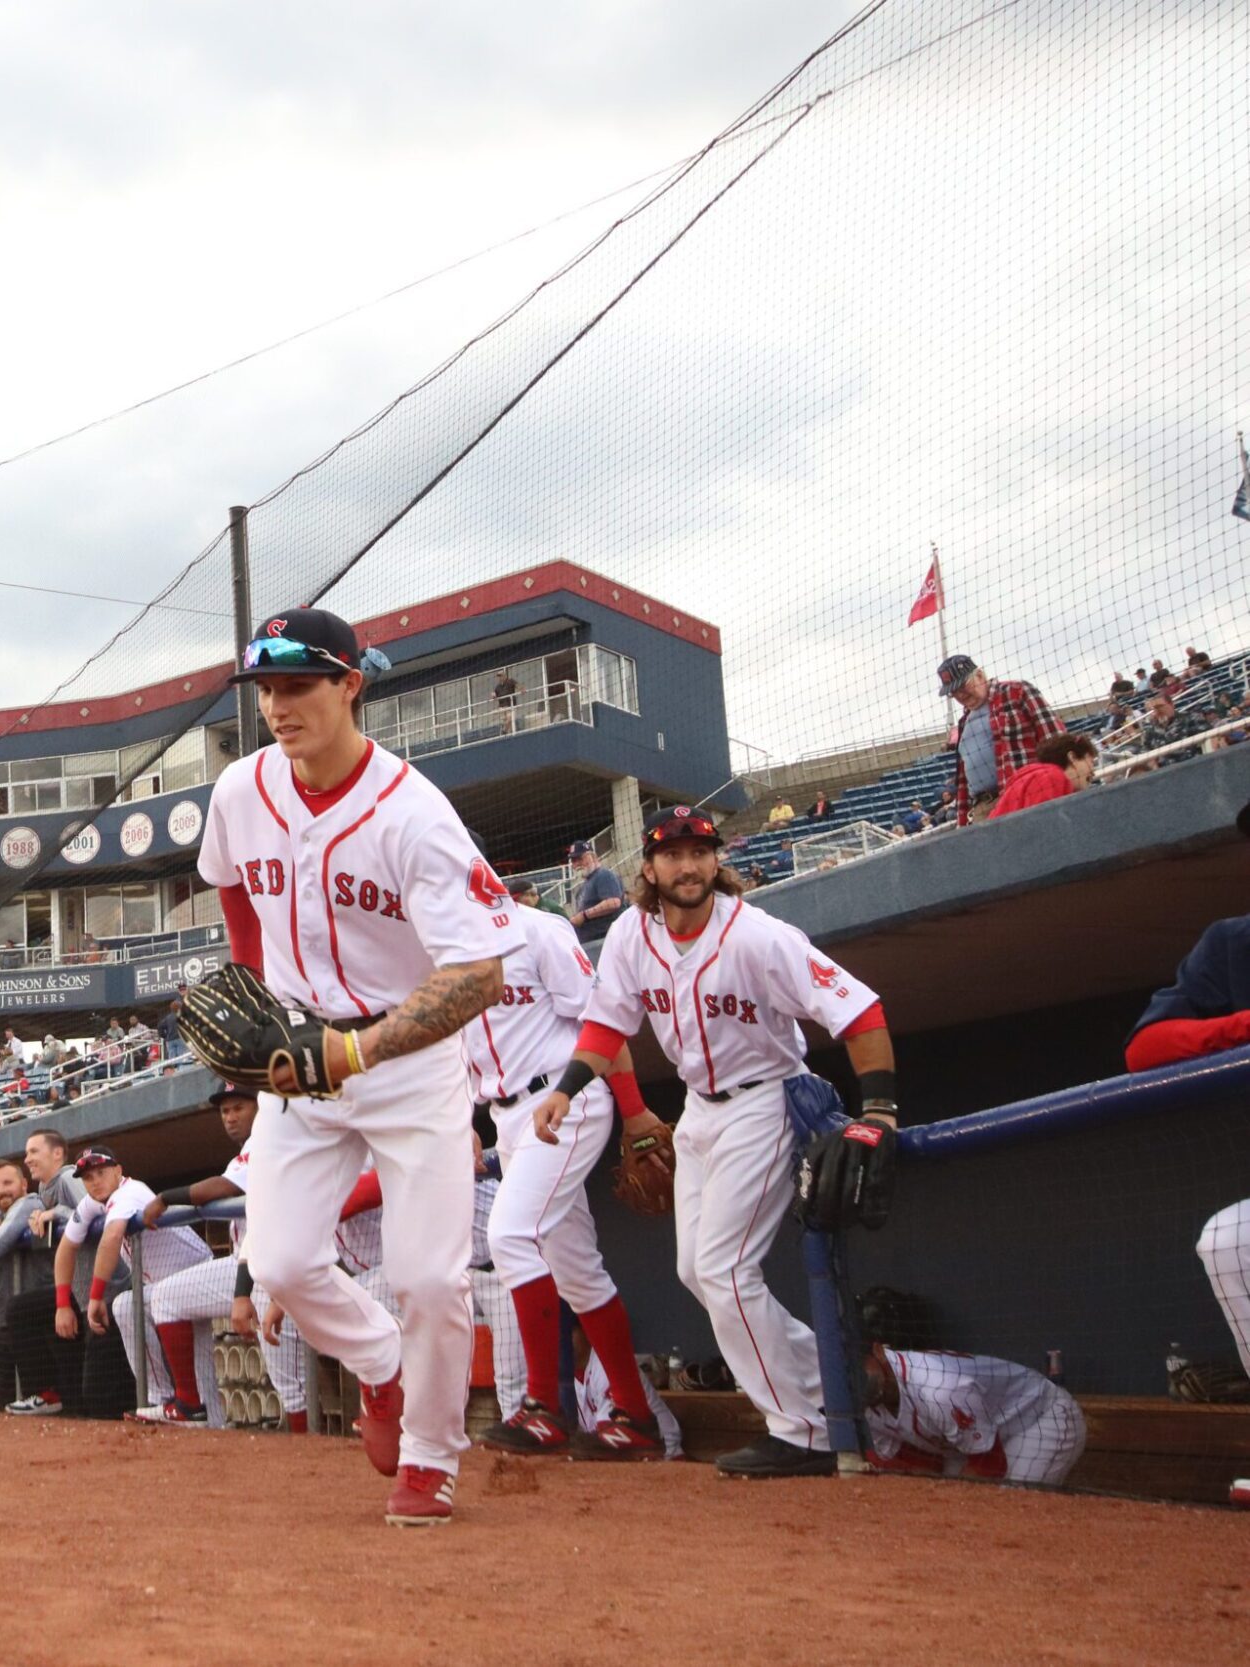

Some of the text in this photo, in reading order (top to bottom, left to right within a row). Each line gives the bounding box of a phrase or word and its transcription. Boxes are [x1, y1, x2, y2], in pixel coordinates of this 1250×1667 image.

[173, 814, 197, 833] 2009
[125, 827, 150, 844] 2006
[6, 841, 35, 856] 1988
[334, 872, 408, 922] SOX
[46, 975, 56, 988] &
[59, 974, 91, 987] SONS
[136, 957, 219, 986] ETHOS
[1, 993, 66, 1009] JEWELERS
[496, 984, 536, 1006] OX
[703, 993, 759, 1024] SOX
